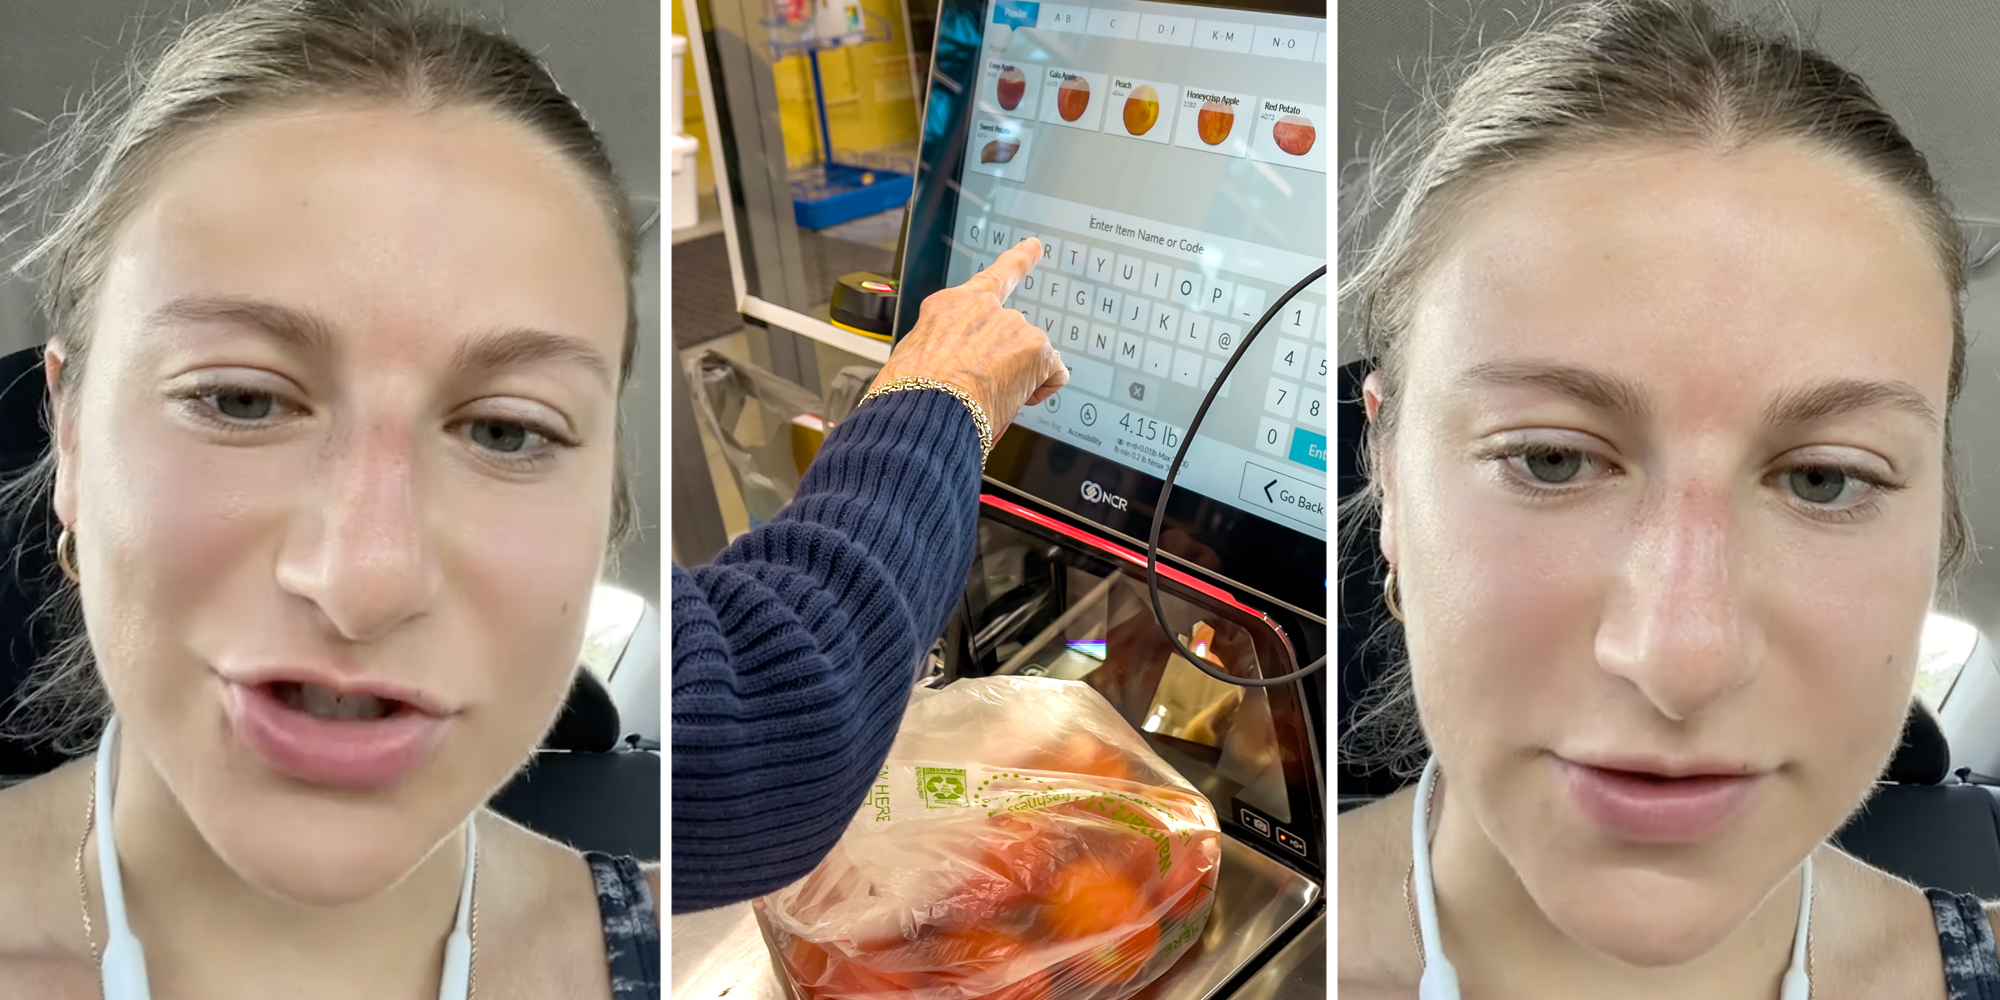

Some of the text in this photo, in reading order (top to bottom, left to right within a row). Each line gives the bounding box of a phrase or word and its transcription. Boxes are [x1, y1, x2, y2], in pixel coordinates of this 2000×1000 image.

[1004, 7, 1027, 18] Popular
[1110, 19, 1116, 28] C
[989, 62, 1015, 72] Envy Apple
[1049, 70, 1077, 82] Gala Apple
[1115, 80, 1132, 89] Peach
[1186, 90, 1240, 106] Honeycrisp Apple
[1264, 102, 1301, 114] Red Potato
[979, 123, 1010, 135] Sweet Potato
[1091, 217, 1205, 255] Enter Item Name or Code
[970, 225, 980, 243] Q
[993, 230, 1005, 246] W
[1043, 244, 1052, 259] R
[1071, 250, 1078, 266] T
[1096, 257, 1105, 272] Y
[1123, 264, 1133, 280] U
[1180, 280, 1192, 296] O
[1212, 288, 1222, 303] P
[1025, 275, 1034, 290] D
[1051, 283, 1059, 297] F
[1076, 290, 1086, 305] G
[1102, 297, 1113, 314] H
[1131, 307, 1139, 321] J
[1159, 313, 1170, 330] K
[1190, 322, 1197, 338] L
[1218, 332, 1231, 350] @
[1293, 309, 1302, 326] 1
[1045, 318, 1054, 332] V
[1070, 325, 1079, 341] B
[1096, 334, 1106, 350] N
[1122, 341, 1136, 358] M
[1284, 350, 1327, 376] 4 5
[1277, 388, 1320, 416] 7 8
[1036, 416, 1062, 432] Own Bag
[1119, 412, 1178, 448] 4.15 lb
[1067, 428, 1102, 447] Accessibility
[1267, 428, 1277, 444] 0
[1120, 449, 1130, 457] min
[1131, 452, 1140, 461] 0.2
[1141, 455, 1148, 463] lb
[1148, 458, 1164, 470] Nmax
[1158, 452, 1171, 462] Max
[1102, 492, 1128, 512] NCR
[1279, 489, 1325, 515] Go Back
[875, 784, 891, 822] HERE
[1007, 793, 1071, 812] freshness
[1110, 805, 1172, 880] Walmart
[1164, 923, 1199, 958] HERE
